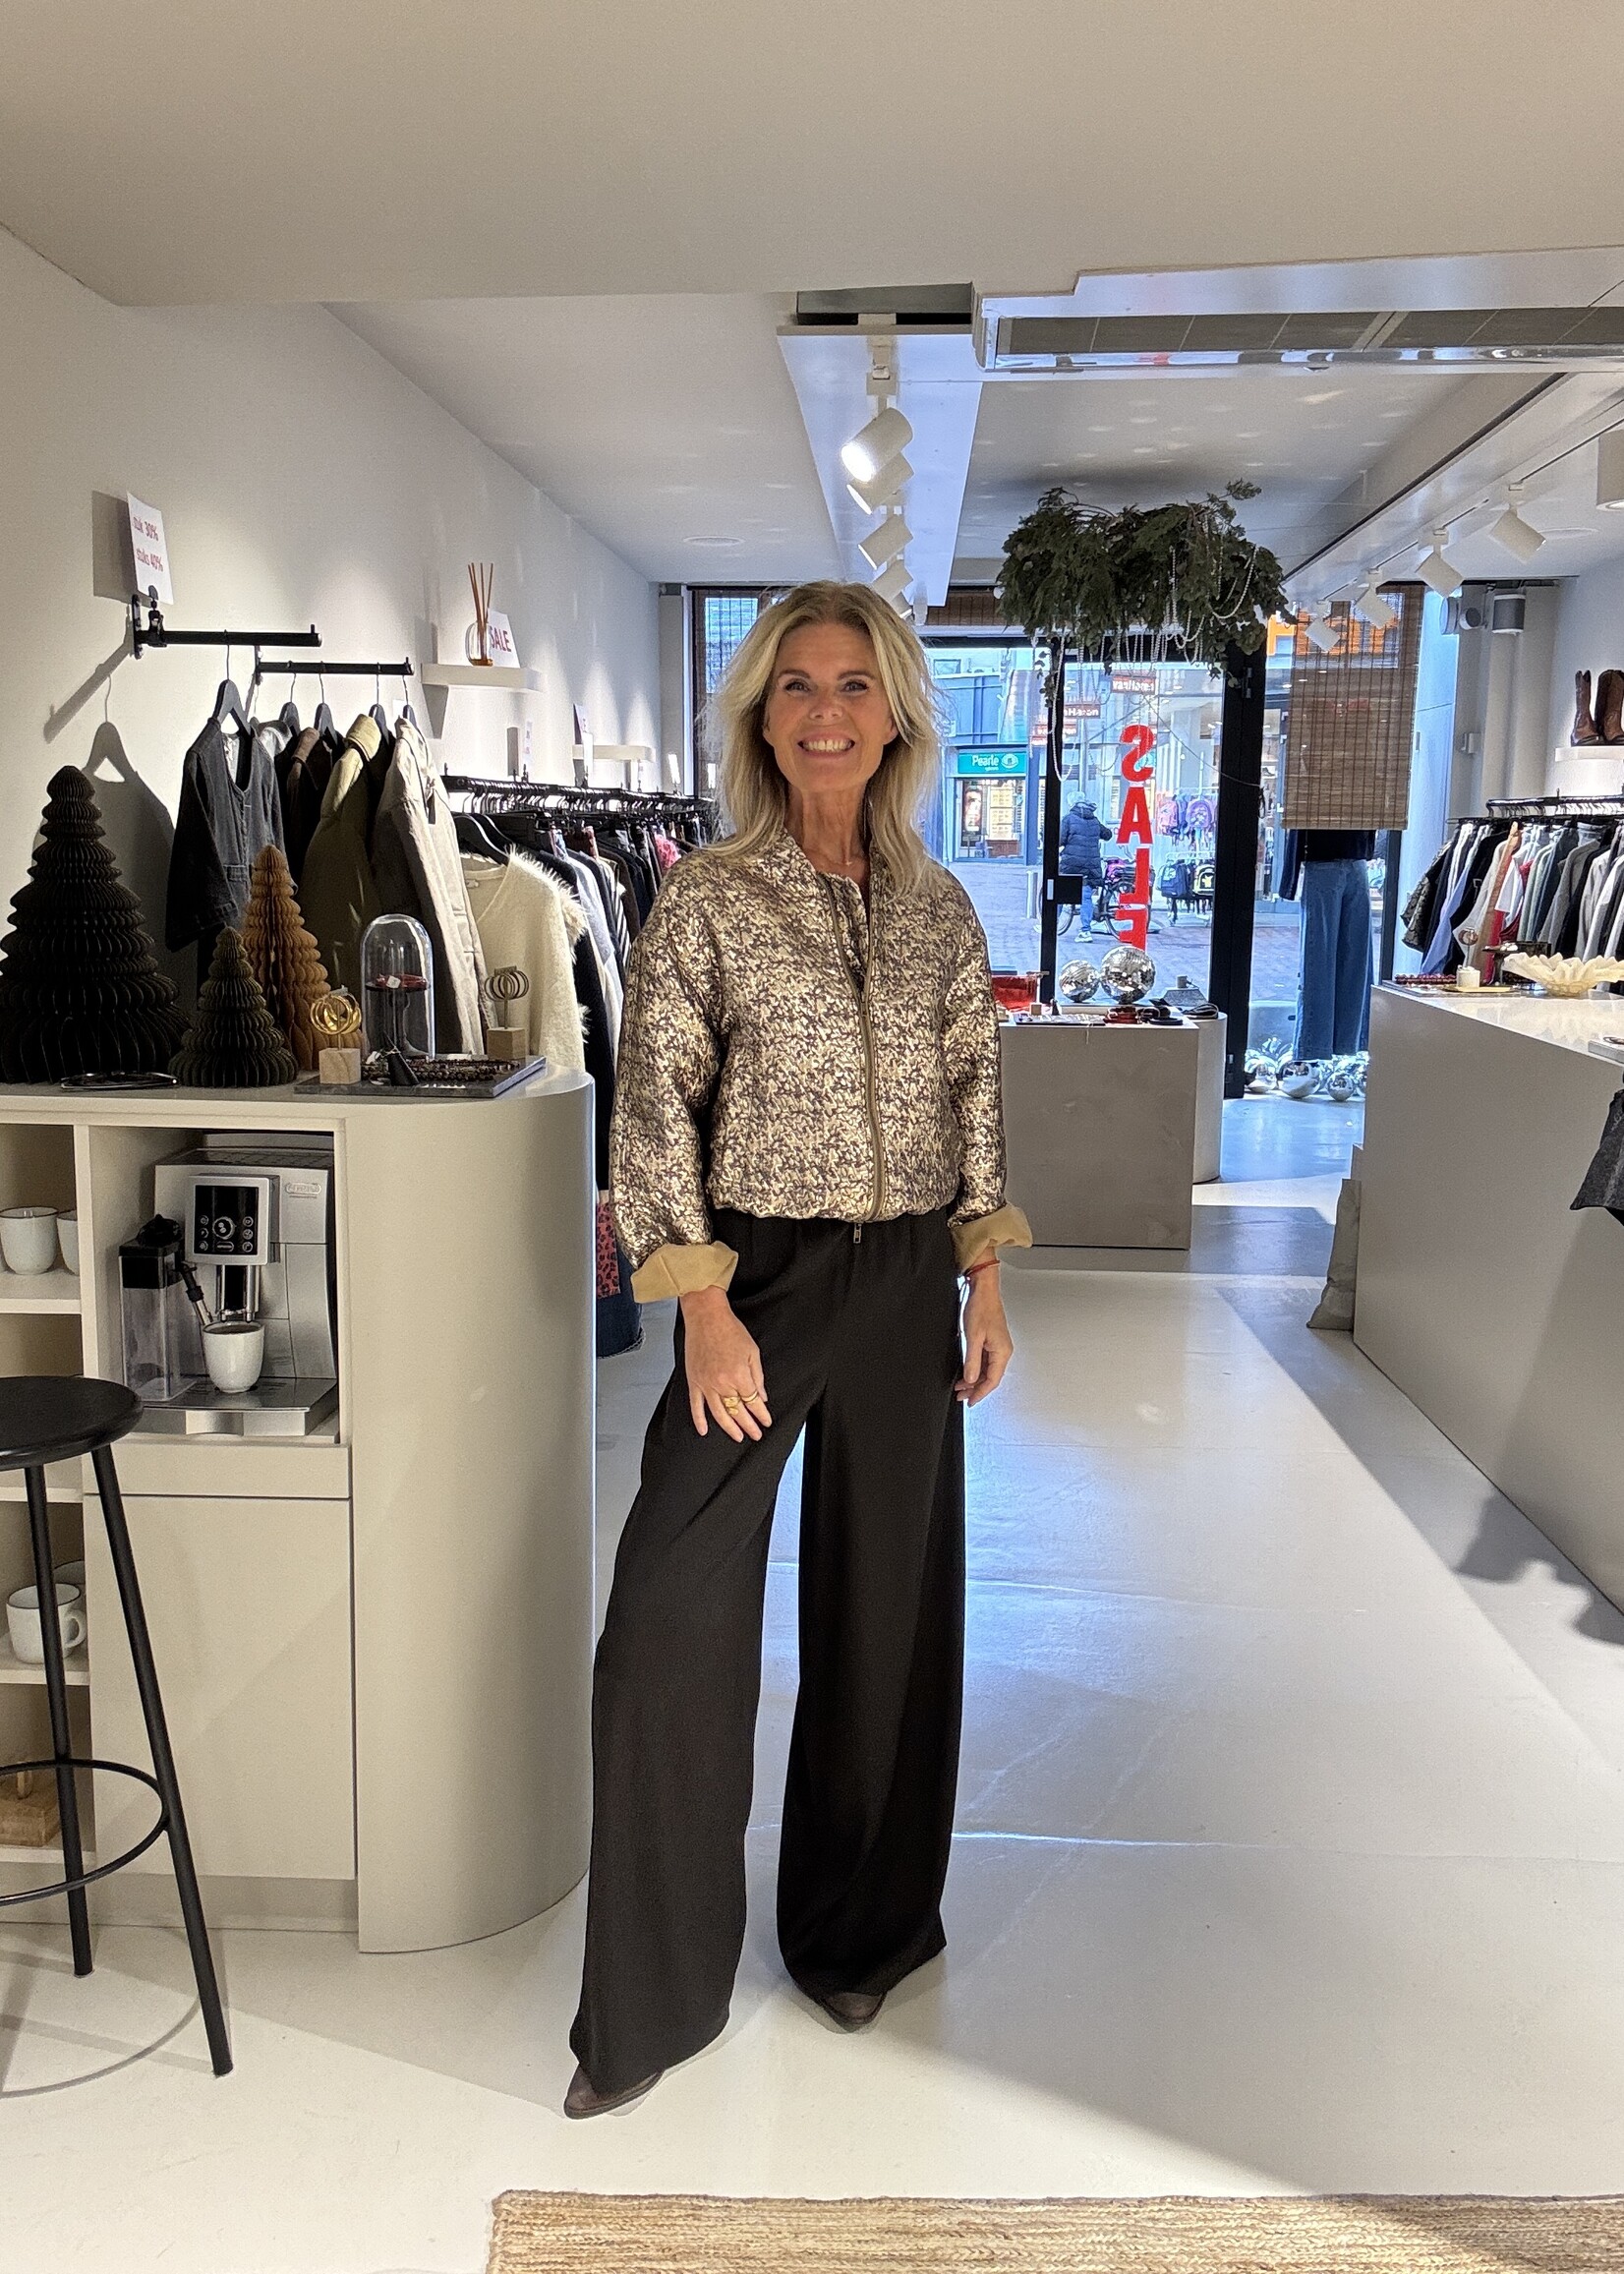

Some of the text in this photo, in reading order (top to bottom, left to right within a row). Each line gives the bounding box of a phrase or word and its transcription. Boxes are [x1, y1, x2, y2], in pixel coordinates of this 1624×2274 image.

[150, 554, 163, 571] 40%
[489, 625, 511, 652] SALE
[971, 754, 1000, 767] Pearle
